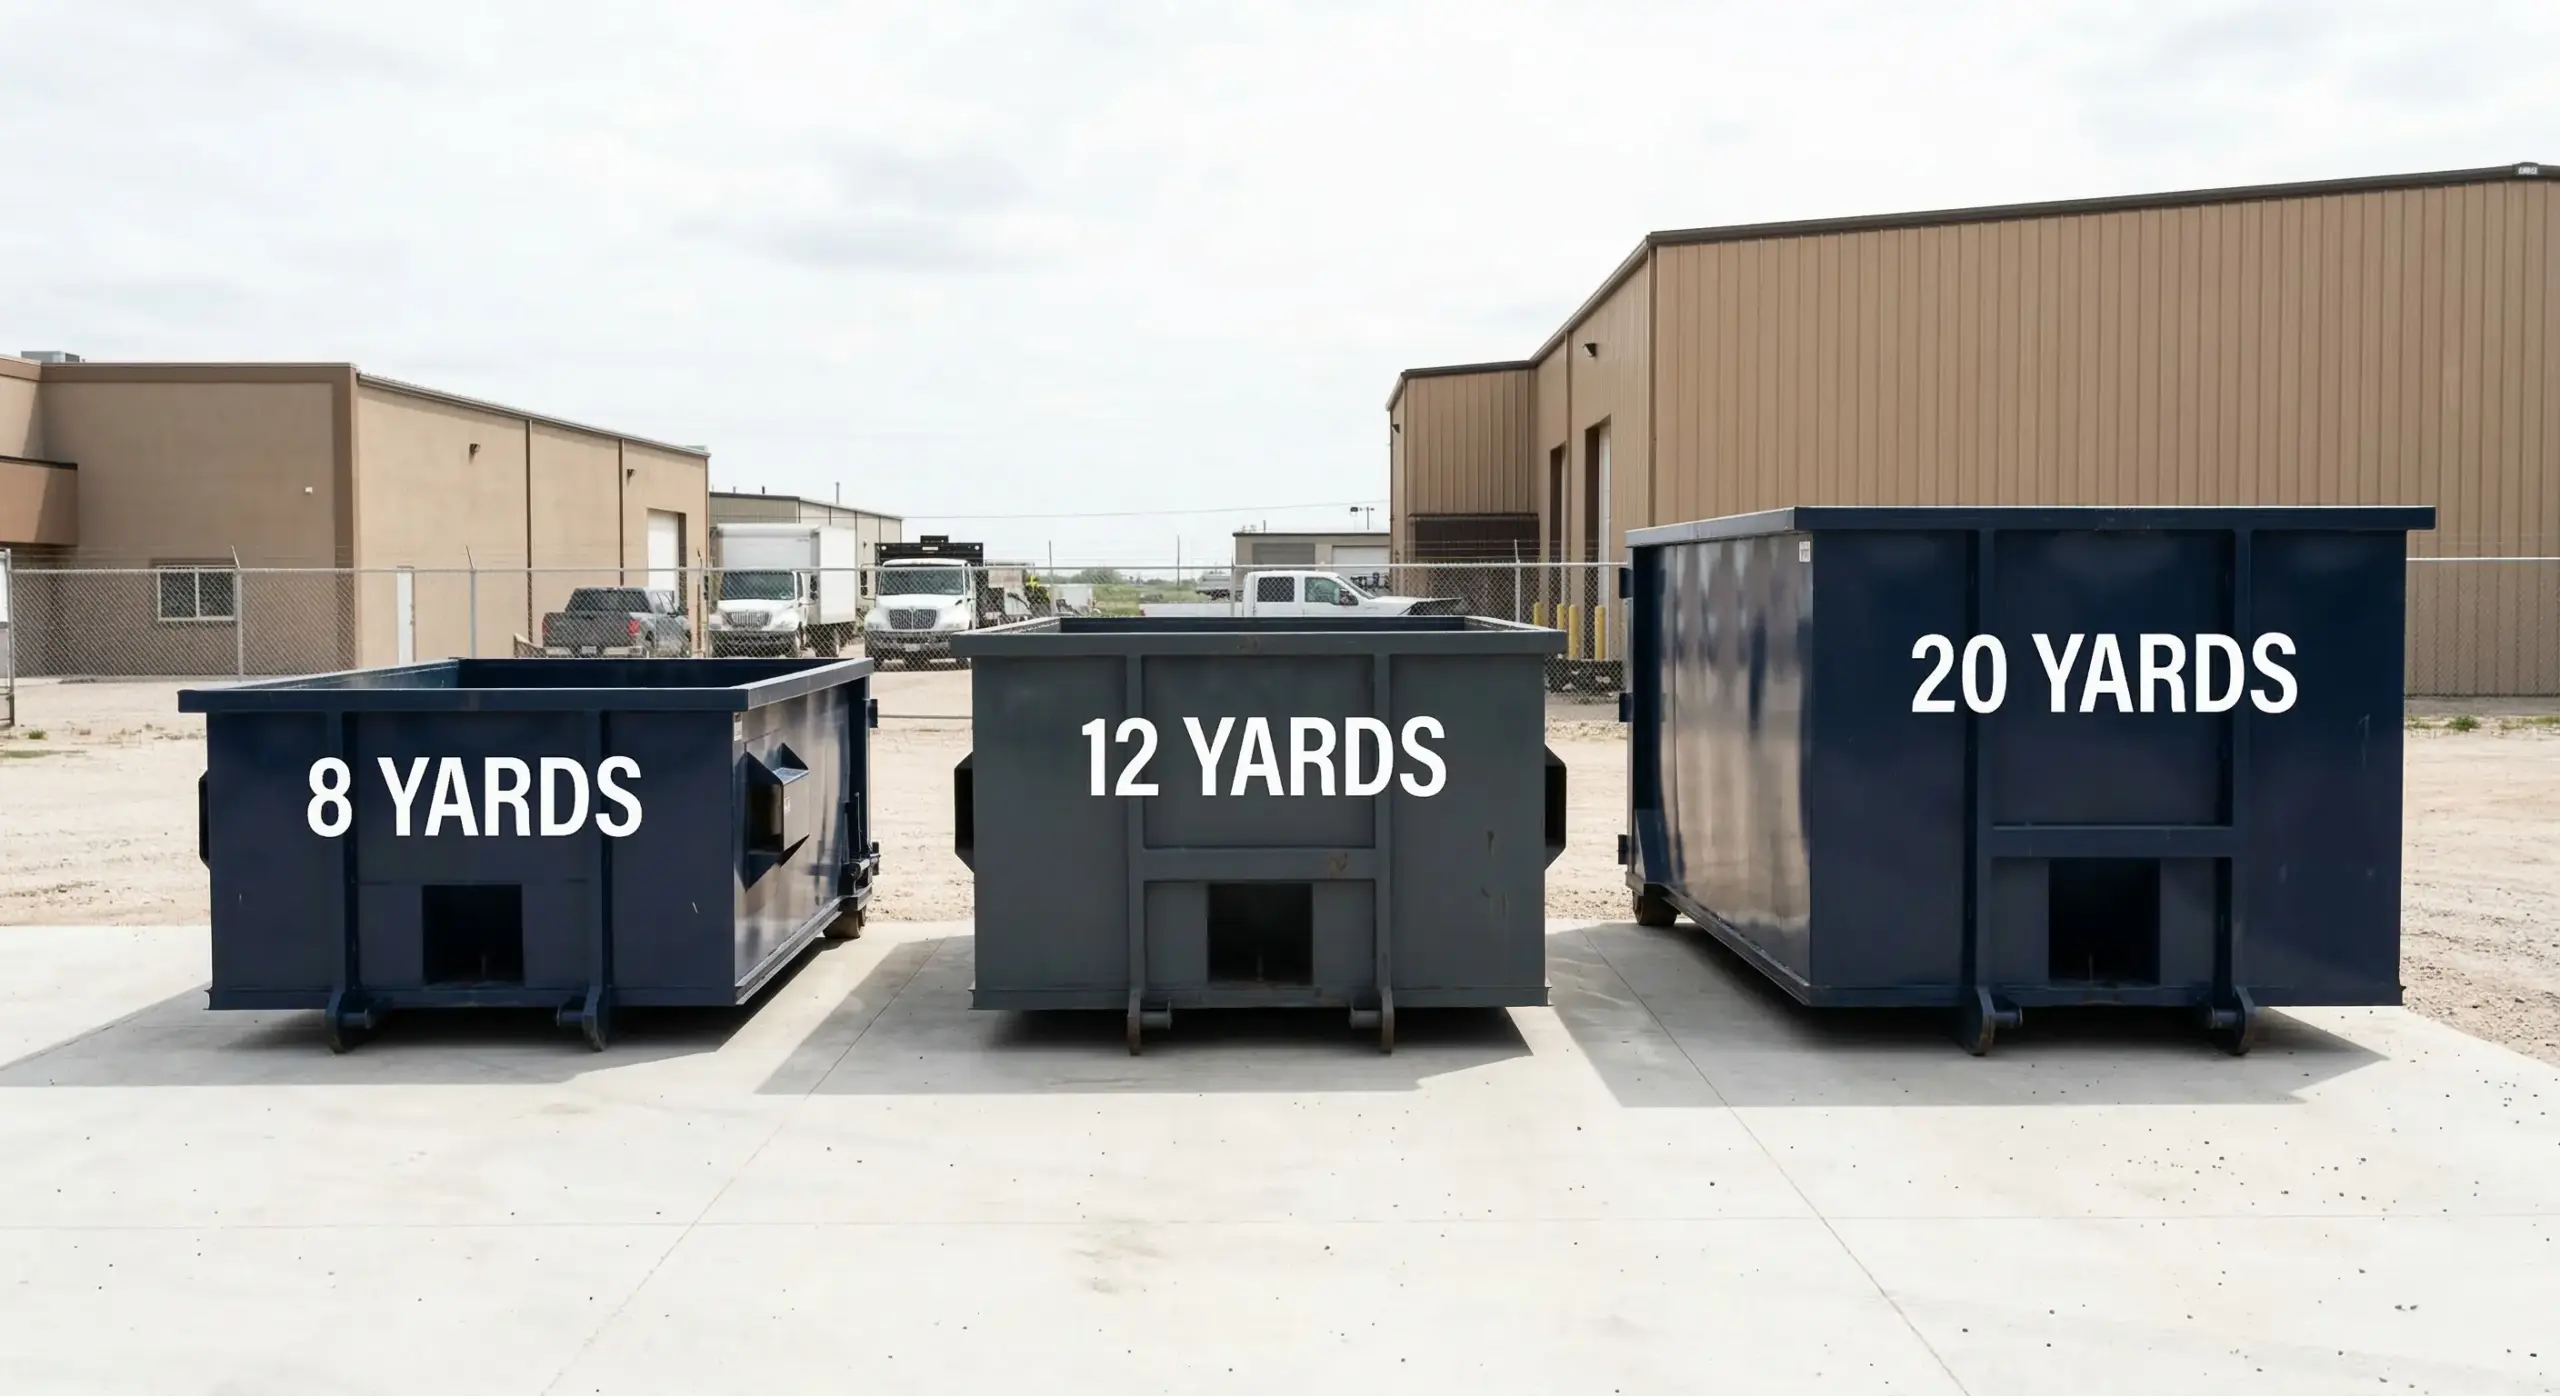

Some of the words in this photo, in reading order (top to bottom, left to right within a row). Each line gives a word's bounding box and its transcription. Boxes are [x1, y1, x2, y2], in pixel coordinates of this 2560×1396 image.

[1912, 633, 2006, 713] 20
[2032, 633, 2298, 713] YARDS
[307, 756, 353, 838] 8
[378, 756, 643, 838] YARDS
[1081, 717, 1158, 796] 12
[1183, 716, 1447, 797] YARDS
